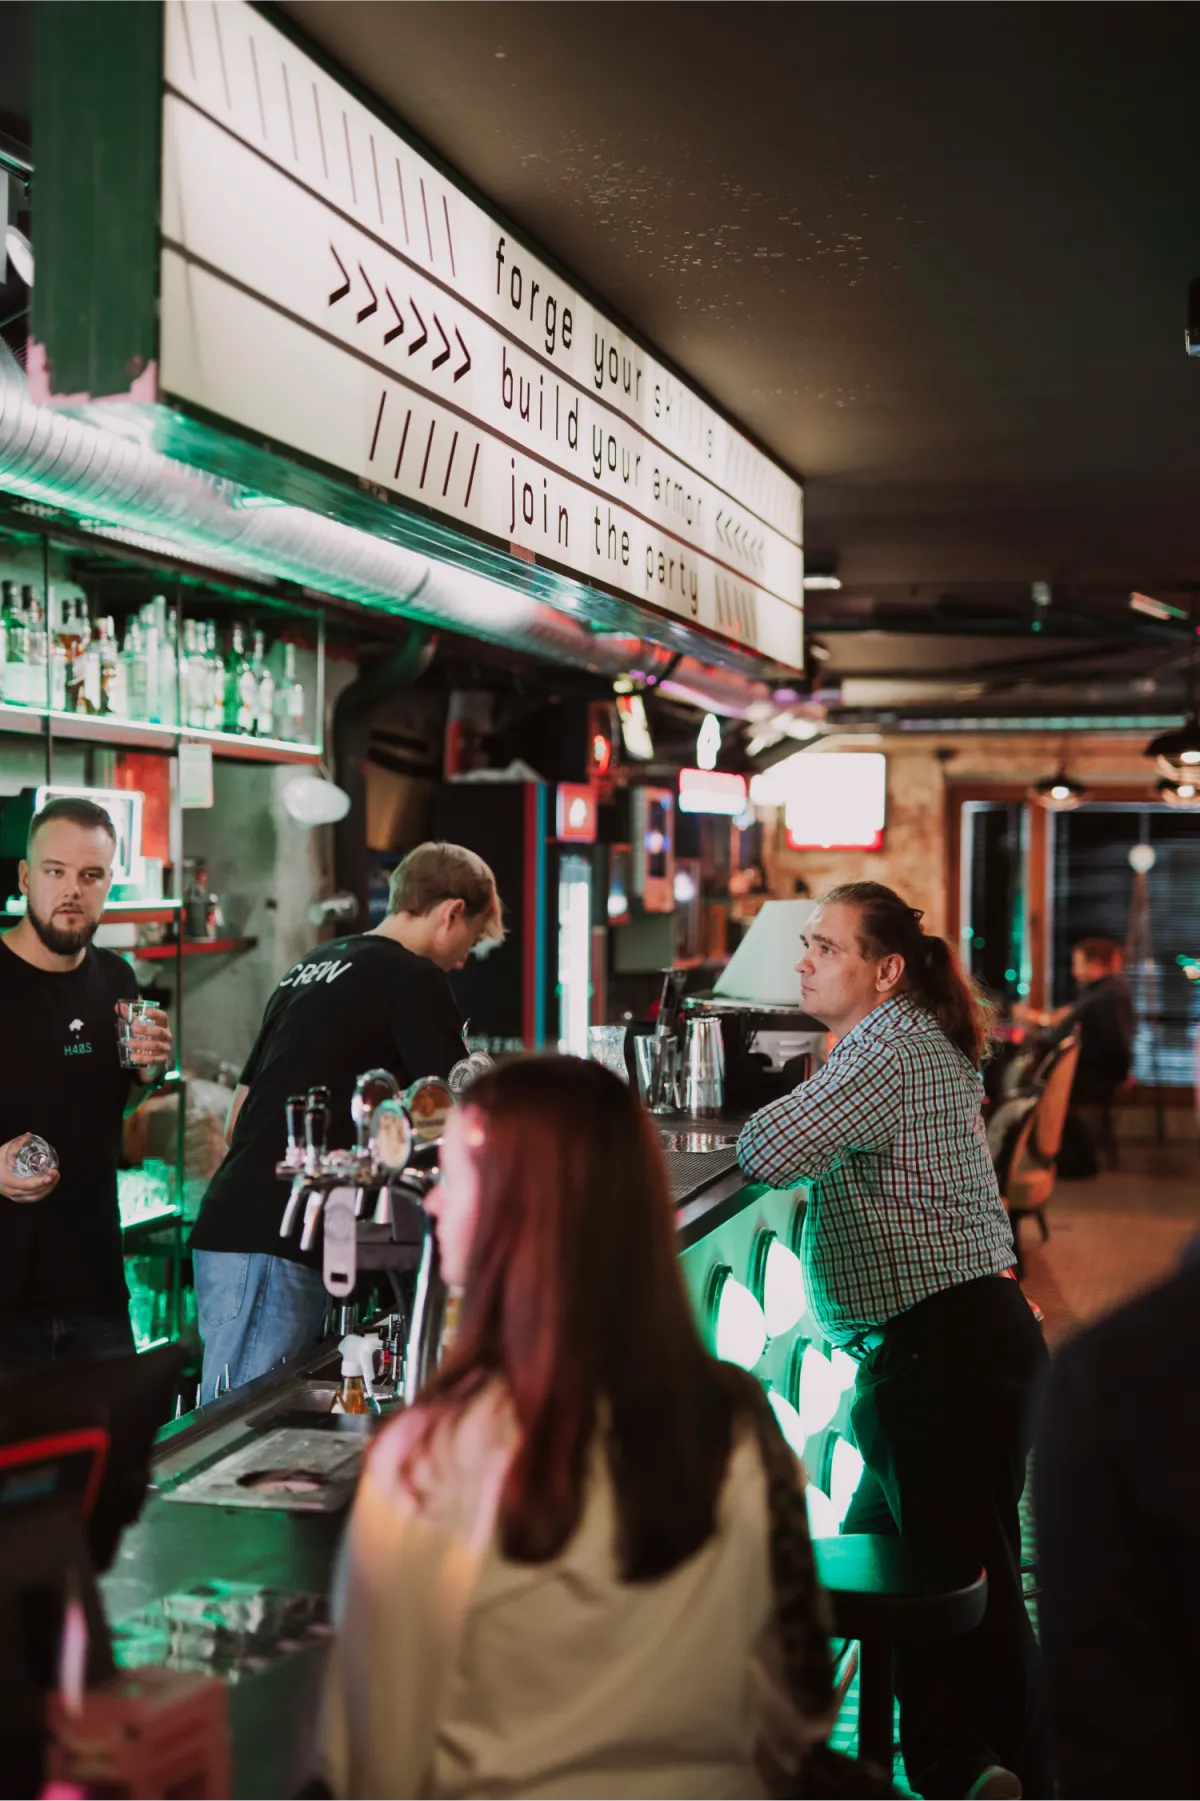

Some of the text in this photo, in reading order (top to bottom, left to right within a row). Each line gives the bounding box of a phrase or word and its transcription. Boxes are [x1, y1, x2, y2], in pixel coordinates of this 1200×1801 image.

[496, 236, 714, 459] forge your skills
[501, 345, 702, 527] build your armor
[509, 456, 698, 616] join the party
[279, 959, 353, 988] CREW
